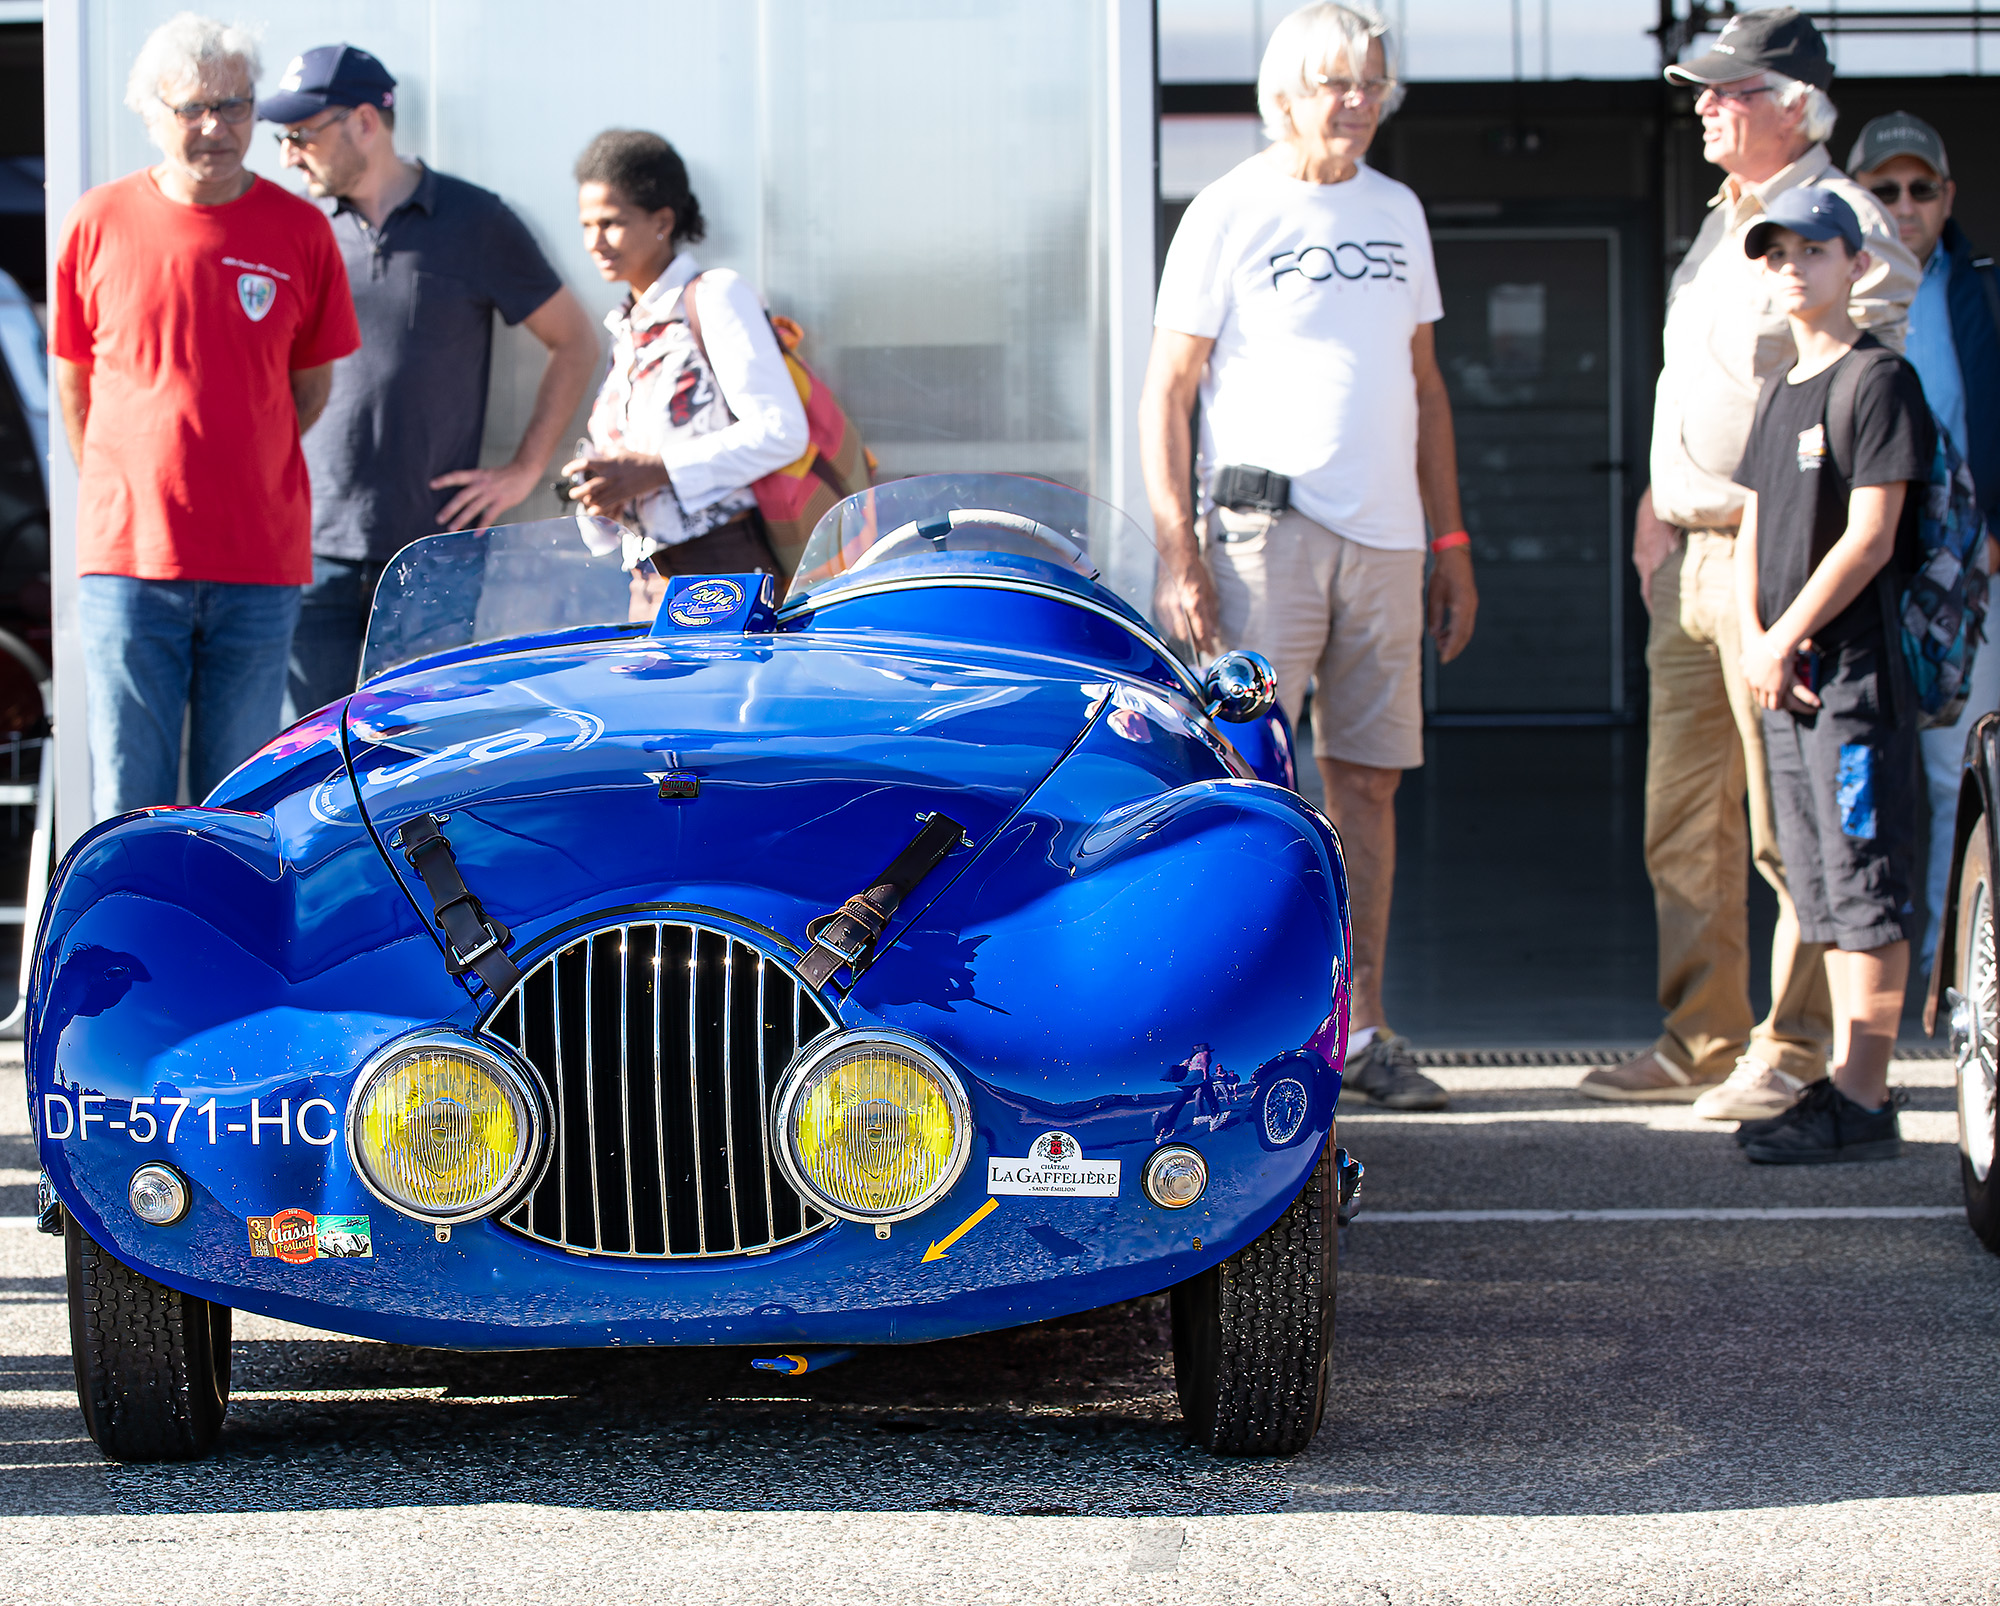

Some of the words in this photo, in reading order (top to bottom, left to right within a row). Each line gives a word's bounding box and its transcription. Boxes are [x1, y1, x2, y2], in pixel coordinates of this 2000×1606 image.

[1270, 241, 1407, 292] FOOSE
[43, 1092, 338, 1146] DF-571-HC
[1040, 1163, 1070, 1171] CHÂTEAU
[268, 1220, 321, 1245] Classic
[276, 1236, 314, 1253] Festival
